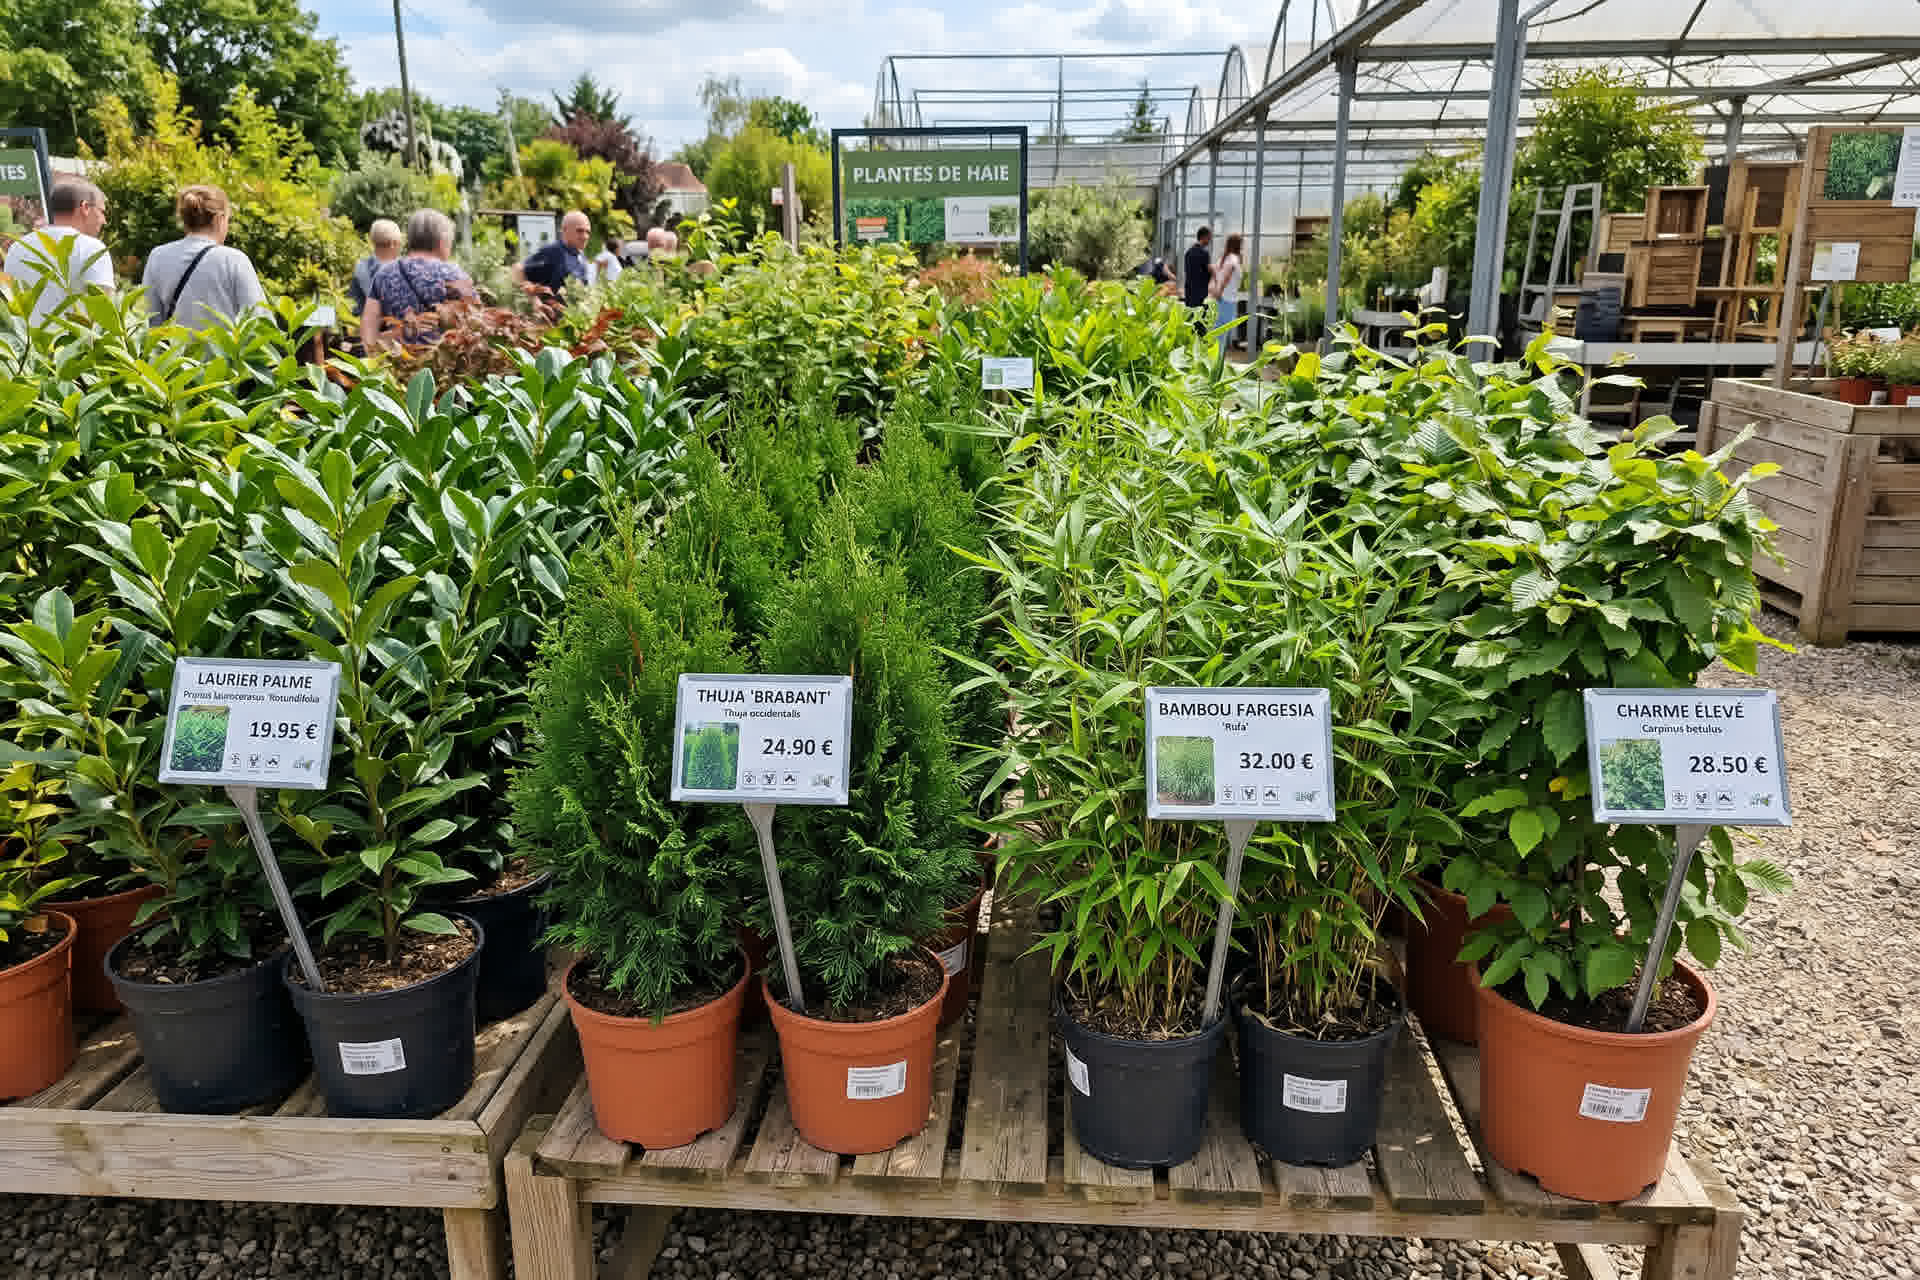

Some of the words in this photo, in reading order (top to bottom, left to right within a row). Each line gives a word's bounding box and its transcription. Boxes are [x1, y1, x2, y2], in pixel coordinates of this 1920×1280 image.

[853, 166, 933, 183] PLANTES
[938, 166, 961, 183] DE
[967, 165, 1009, 182] HAIE
[198, 672, 258, 688] LAURIER
[262, 674, 313, 689] PALME
[697, 689, 745, 703] THUJA
[751, 690, 831, 705] 'BRABANT'
[723, 707, 748, 719] Thuja
[749, 707, 801, 718] occidentalis
[1159, 703, 1231, 717] BAMBOU
[1237, 703, 1314, 717] FARGESIA
[1616, 703, 1689, 718] CHARME
[1695, 701, 1745, 718] ÉLEVÉ
[249, 721, 300, 739] 19.95
[305, 723, 318, 740] €
[1641, 723, 1684, 735] Carpinus
[1685, 723, 1723, 734] betulus
[762, 738, 816, 756] 24.90
[821, 739, 833, 756] €
[1239, 752, 1296, 770] 32.00
[1302, 753, 1314, 770] €
[1689, 755, 1748, 774] 28.50
[1754, 756, 1769, 774] €
